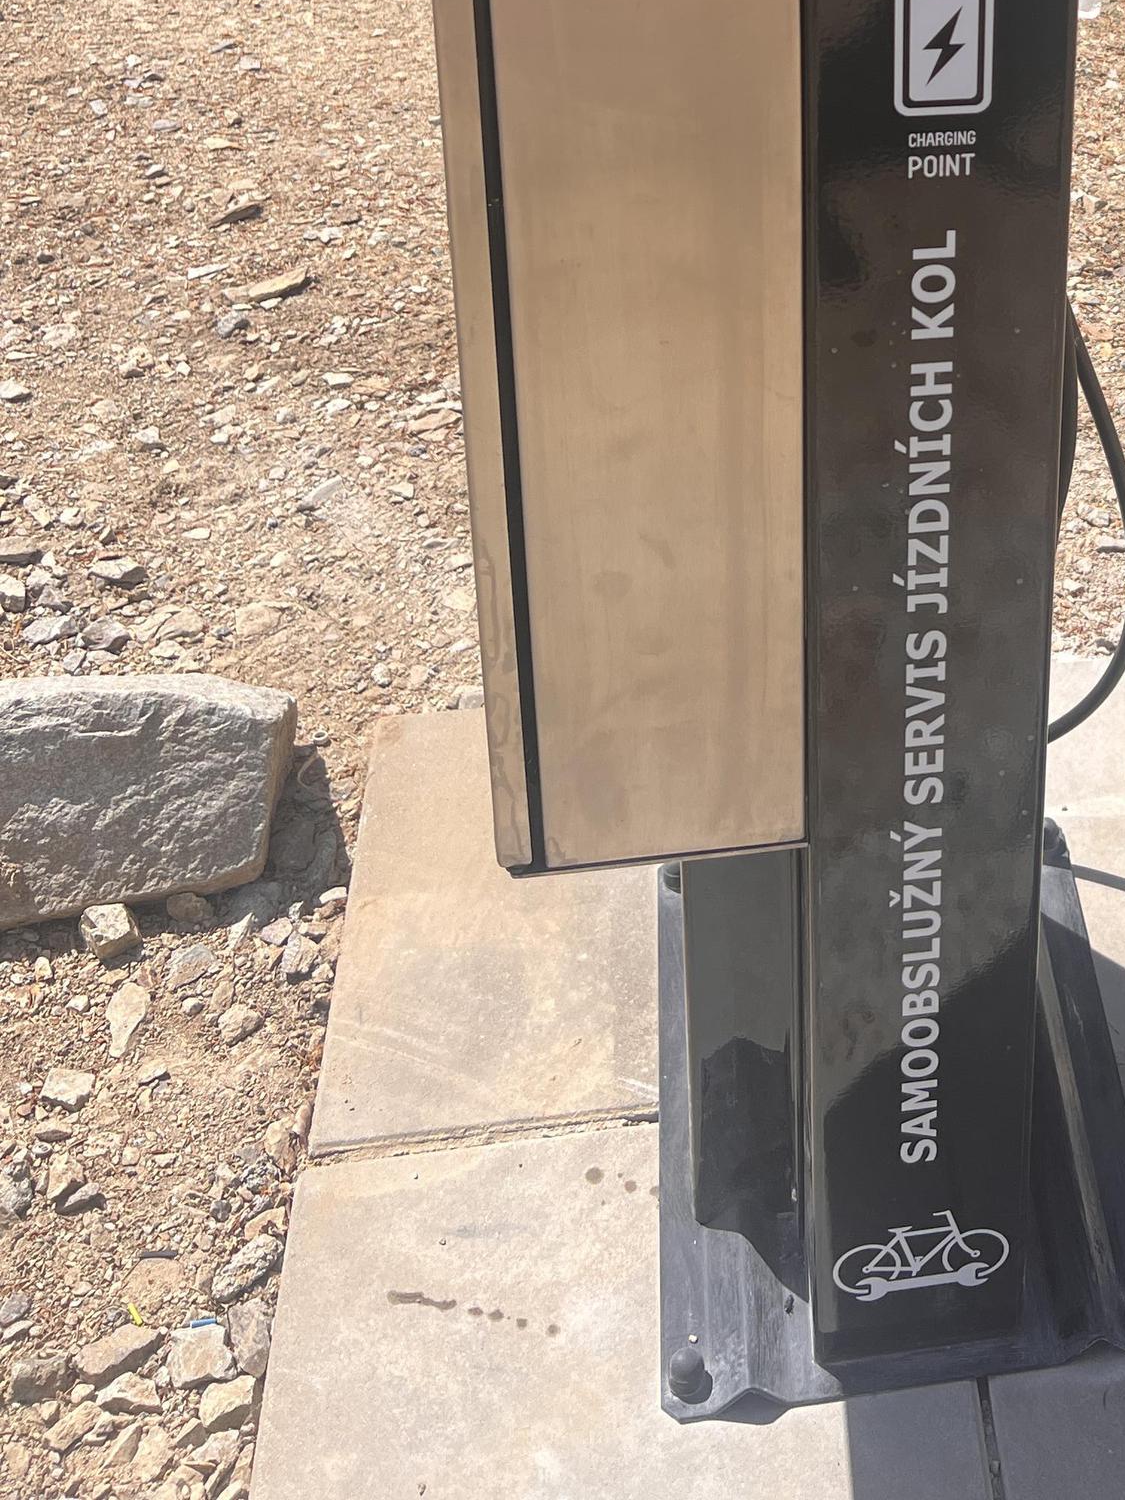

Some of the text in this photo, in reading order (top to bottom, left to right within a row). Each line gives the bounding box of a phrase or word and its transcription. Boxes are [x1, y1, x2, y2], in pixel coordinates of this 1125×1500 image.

[908, 129, 976, 149] CHARGING
[908, 151, 975, 179] POINT
[889, 228, 957, 1164] SAMOOBSLUŽNÝ SERVIS JÍZDNÍCH KOL
